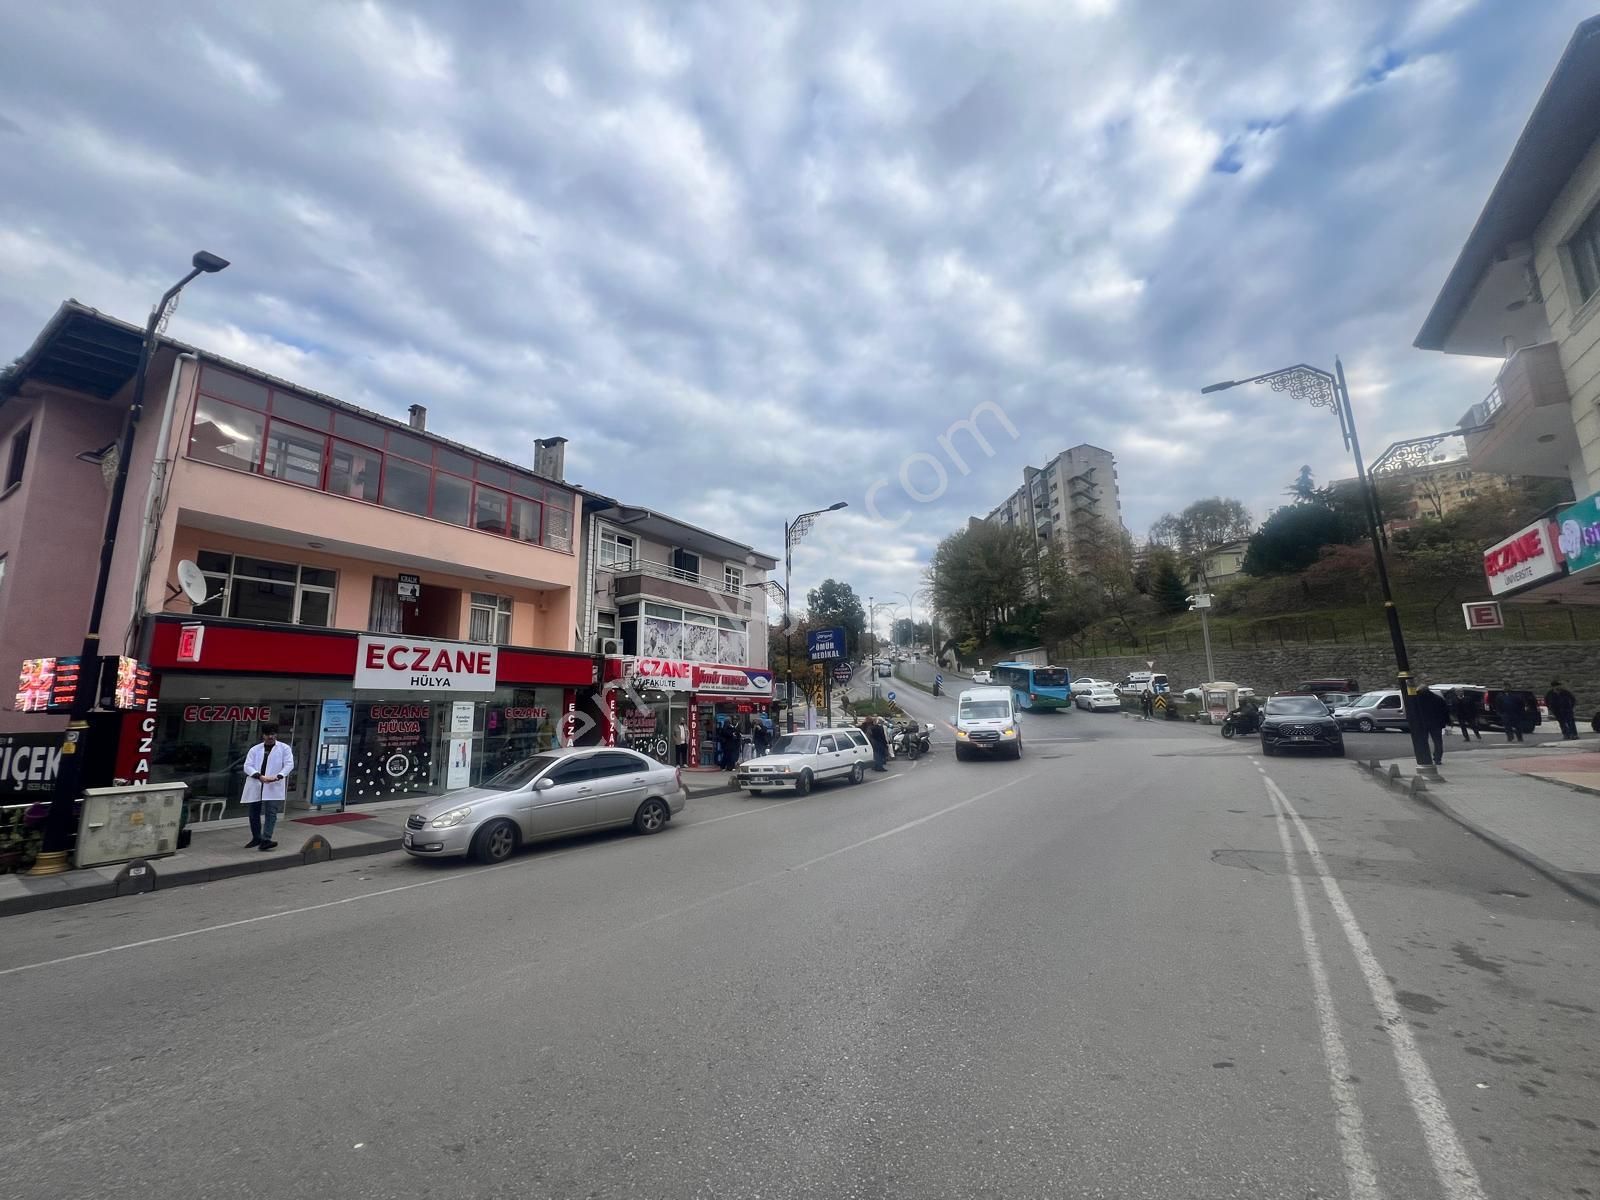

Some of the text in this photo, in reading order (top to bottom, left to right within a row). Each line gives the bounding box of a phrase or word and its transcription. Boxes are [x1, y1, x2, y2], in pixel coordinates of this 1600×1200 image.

[1474, 607, 1495, 625] E
[365, 643, 492, 675] ECZANE
[410, 675, 451, 687] HÜLYA
[184, 705, 272, 722] ECZANE
[370, 704, 430, 719] ECZANE
[504, 706, 548, 720] ECZANE
[377, 719, 421, 734] HÜLYA
[690, 704, 698, 765] MEDİKAL
[0, 737, 63, 791] İÇEK
